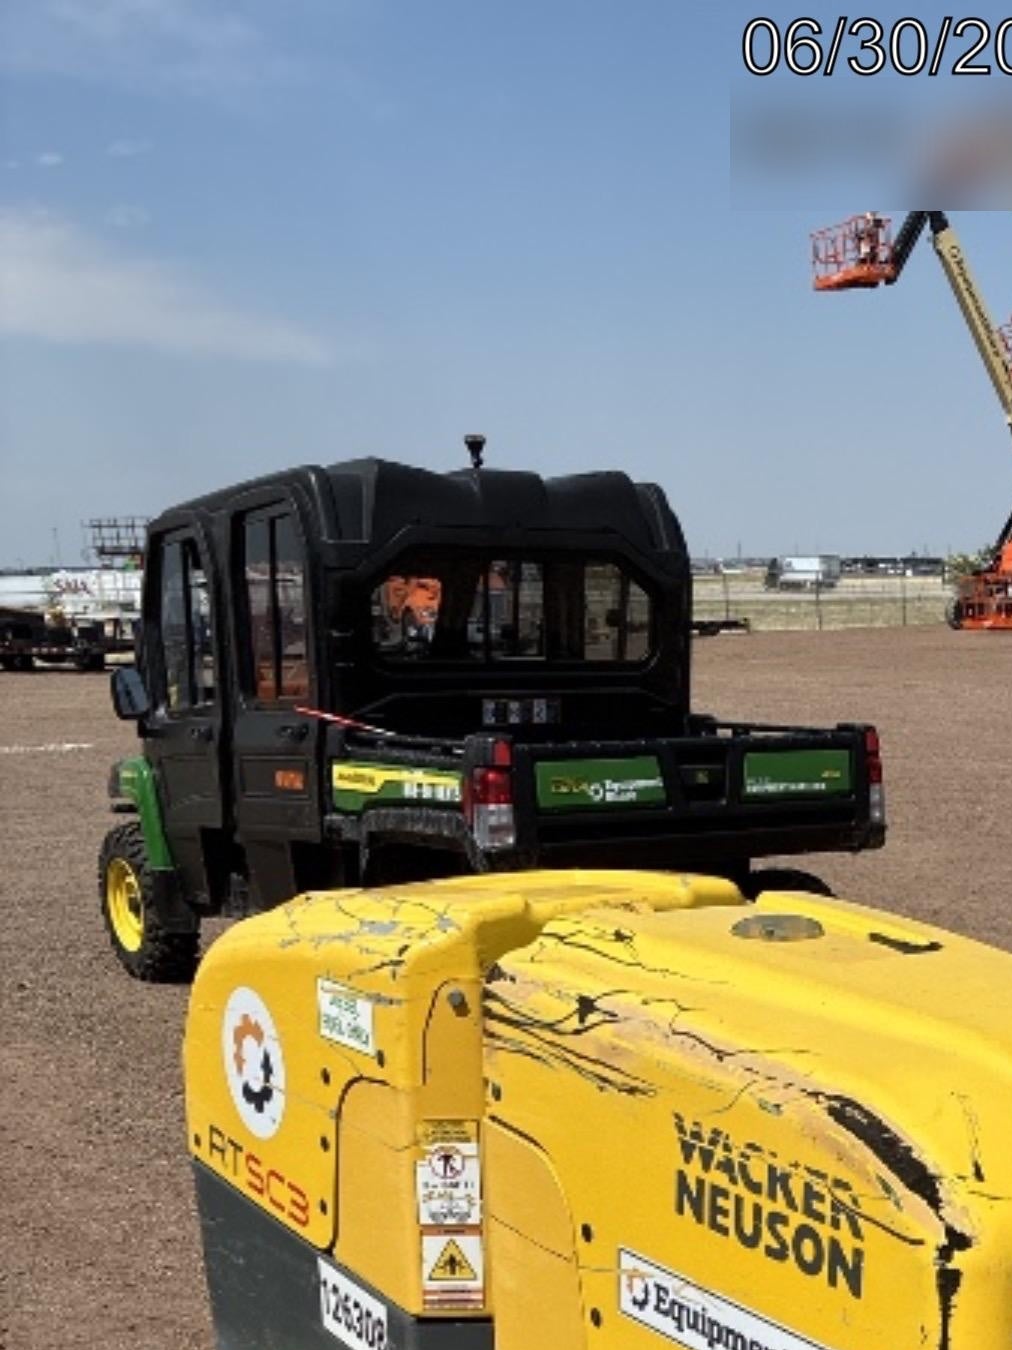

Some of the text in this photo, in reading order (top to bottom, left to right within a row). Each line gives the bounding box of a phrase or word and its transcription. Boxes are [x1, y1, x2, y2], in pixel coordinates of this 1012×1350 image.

[208, 1125, 310, 1228] RTSC3
[674, 1112, 865, 1242] WACKER
[674, 1168, 865, 1300] NEUSON
